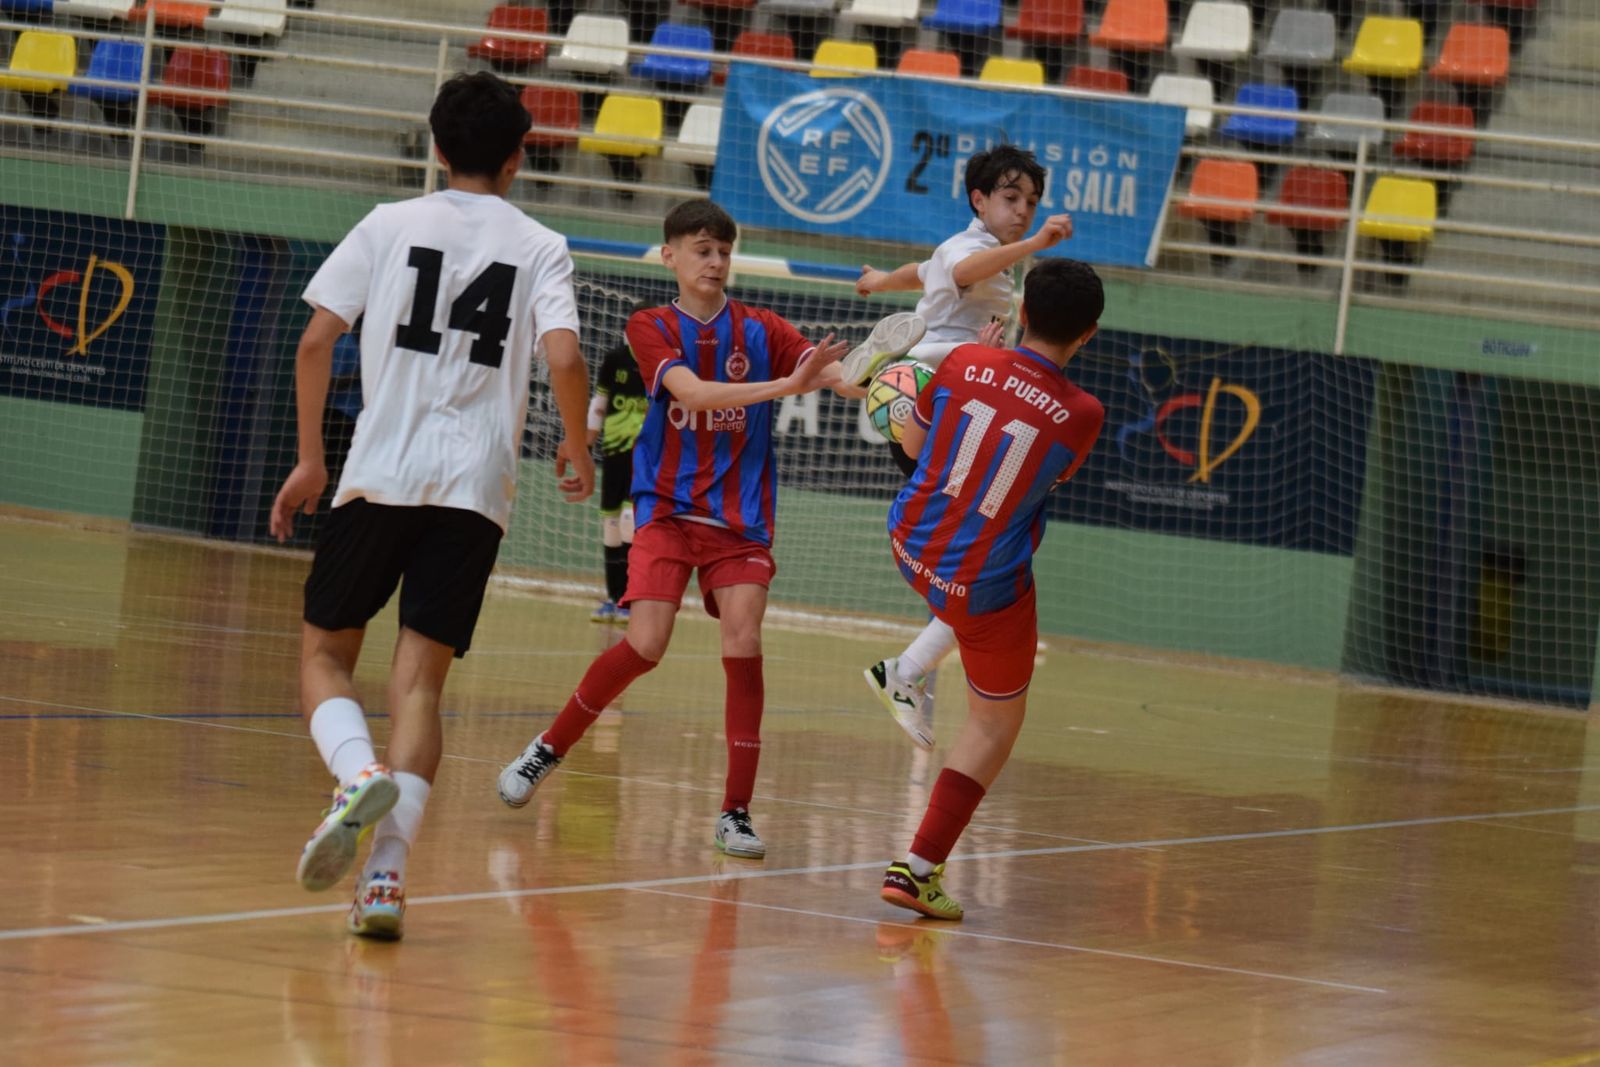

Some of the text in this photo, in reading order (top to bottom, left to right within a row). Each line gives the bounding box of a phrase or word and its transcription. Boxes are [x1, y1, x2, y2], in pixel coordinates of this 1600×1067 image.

[801, 129, 851, 149] RF
[799, 154, 848, 176] EF
[1064, 168, 1136, 217] SALA
[395, 246, 518, 368] 14
[964, 365, 997, 387] C.D.
[1002, 375, 1070, 424] PUERTO
[714, 420, 747, 433] energy
[943, 399, 1041, 519] 11
[892, 538, 923, 574] MUCHO
